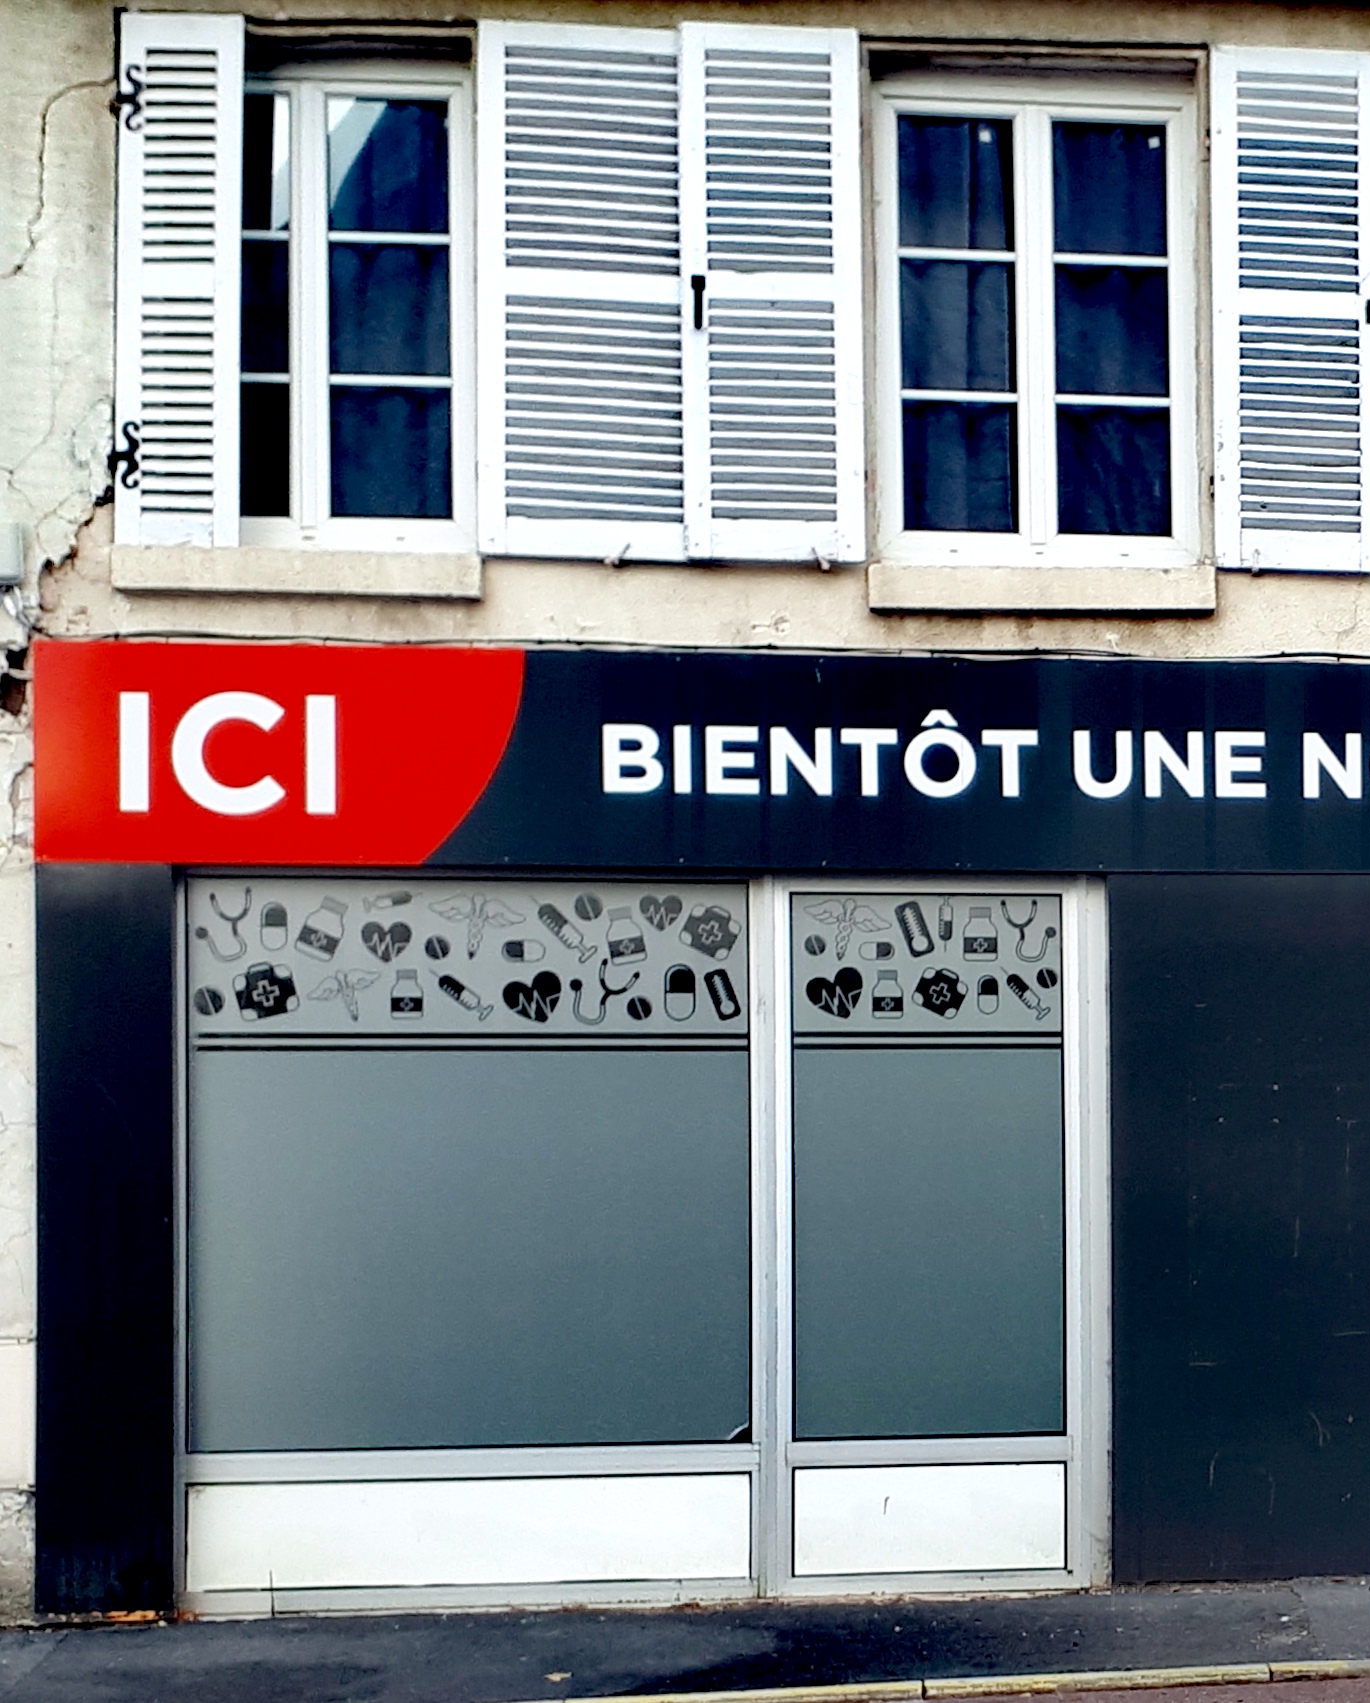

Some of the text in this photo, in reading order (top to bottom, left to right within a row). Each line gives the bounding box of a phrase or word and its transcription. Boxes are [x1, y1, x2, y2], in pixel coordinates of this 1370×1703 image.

[119, 691, 336, 815] ICI
[602, 709, 1038, 798] BIENTÔT
[1073, 730, 1267, 799] UNE
